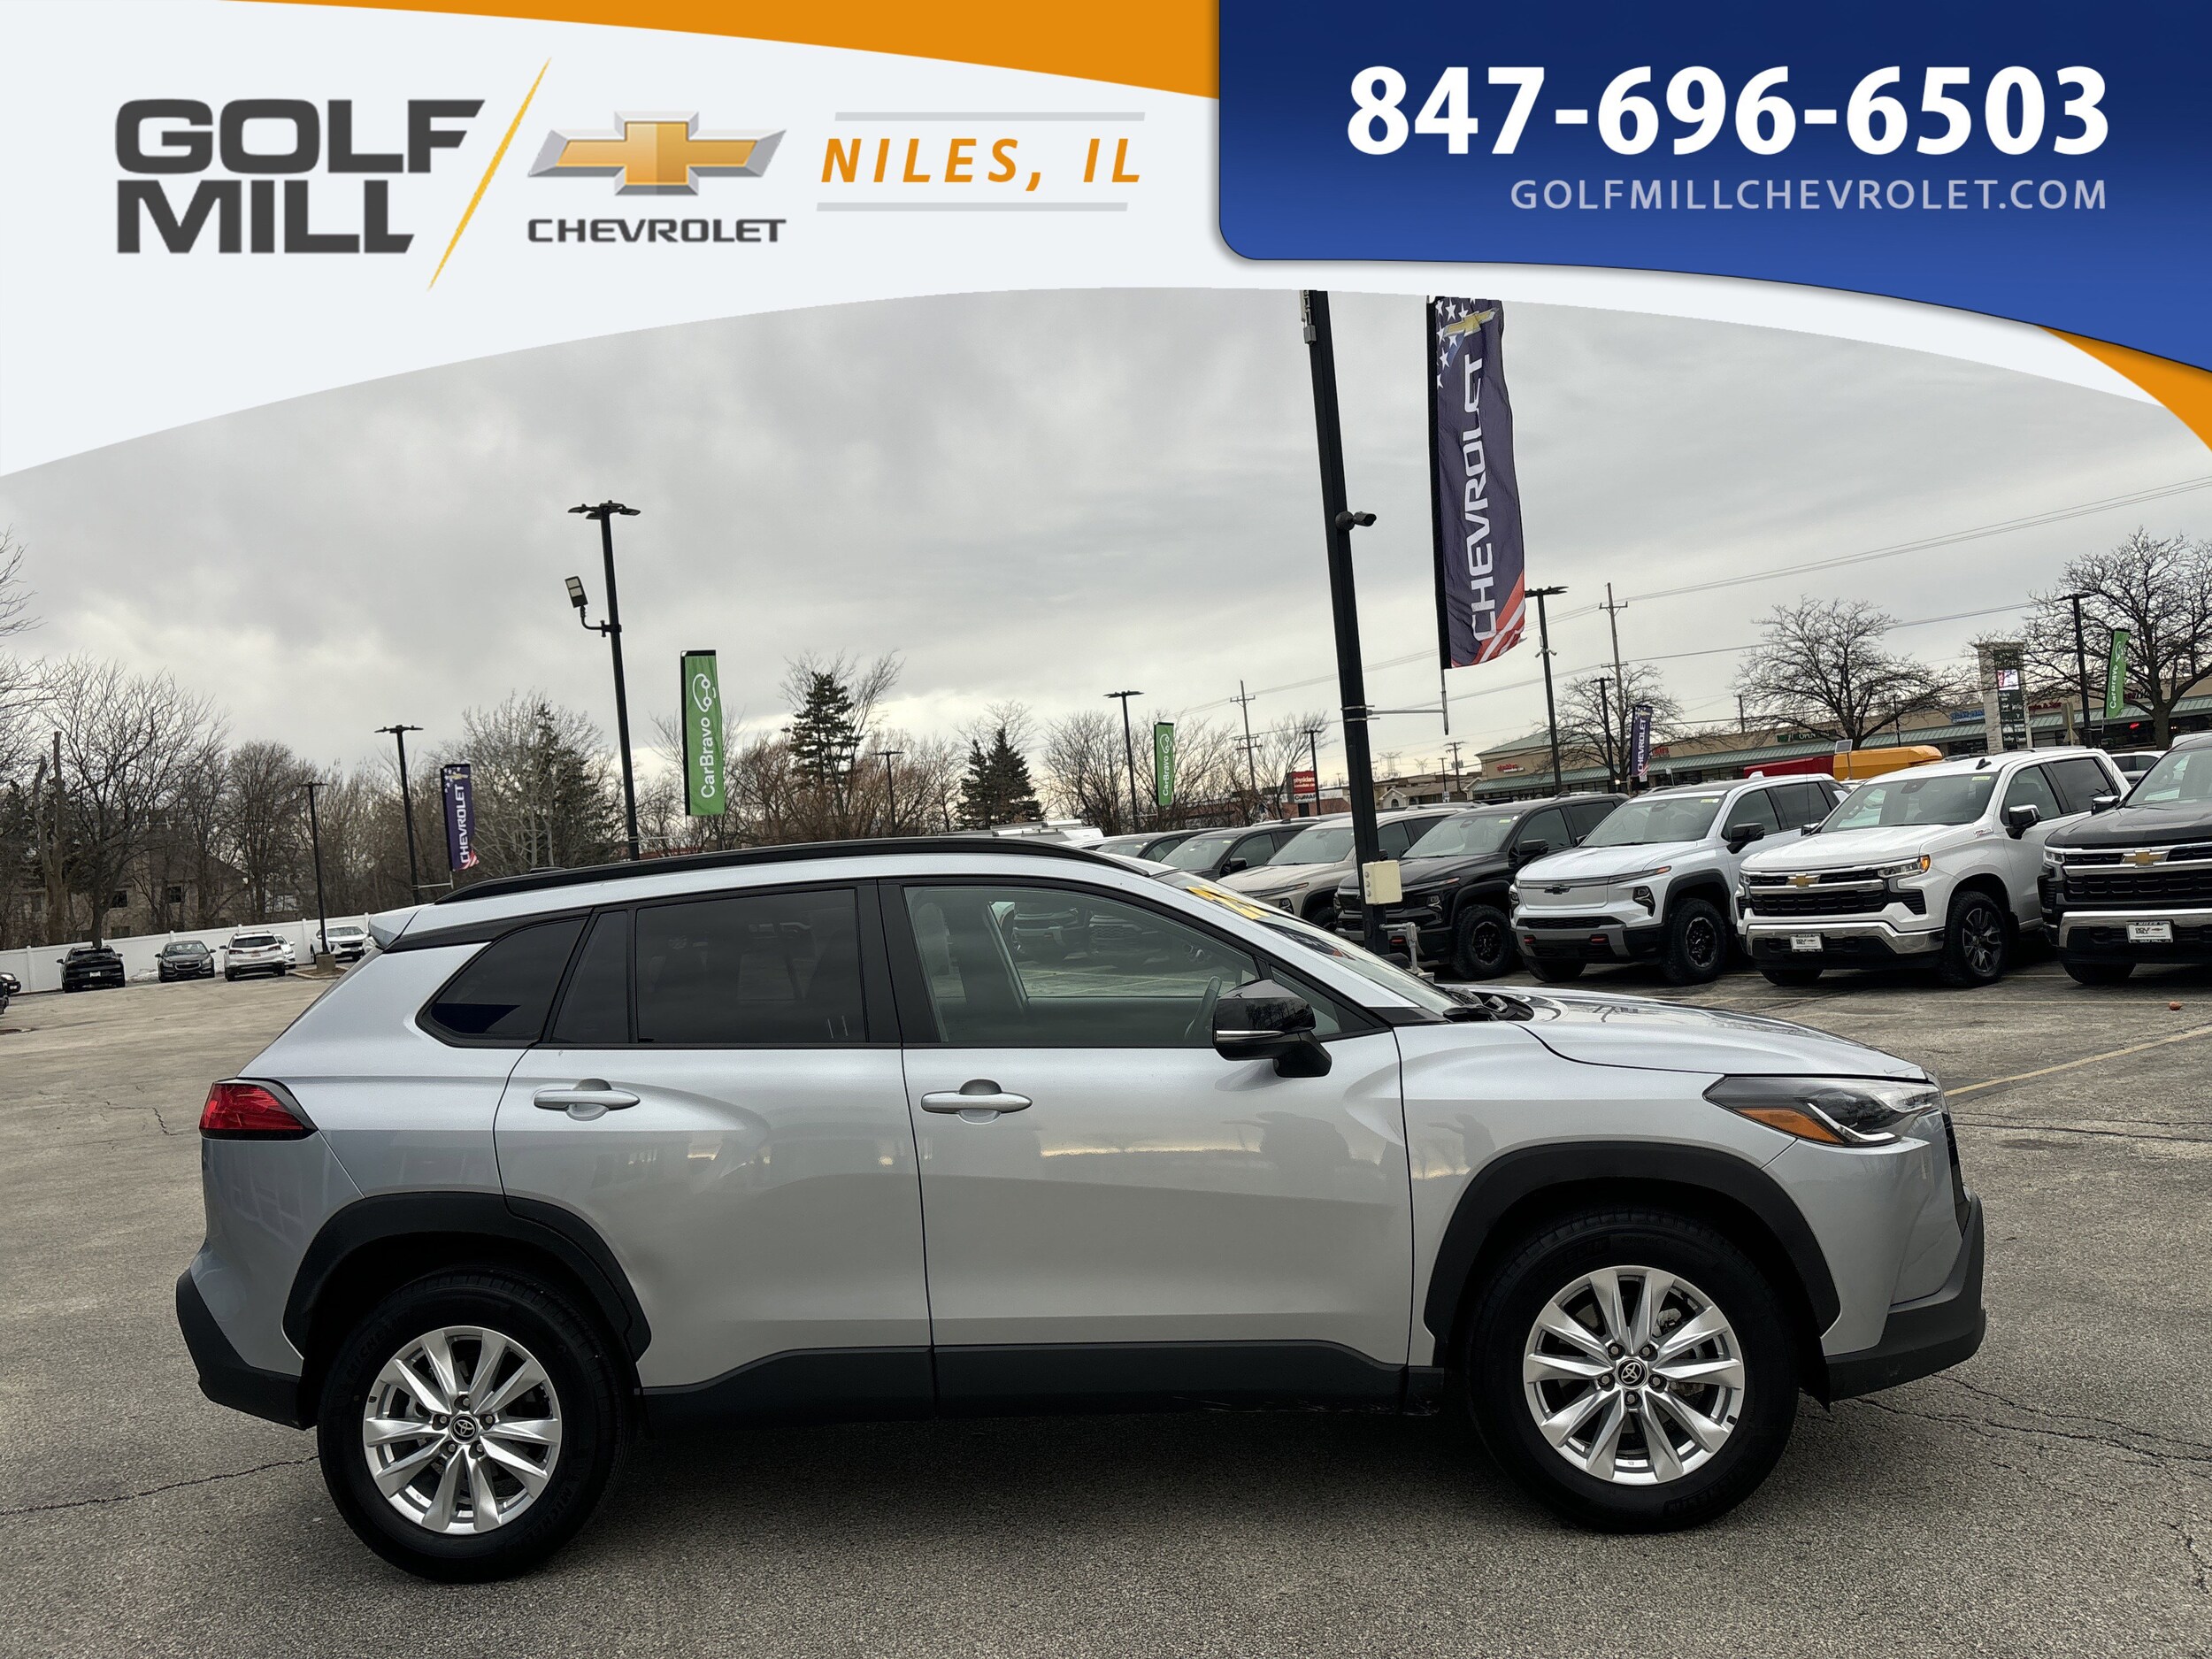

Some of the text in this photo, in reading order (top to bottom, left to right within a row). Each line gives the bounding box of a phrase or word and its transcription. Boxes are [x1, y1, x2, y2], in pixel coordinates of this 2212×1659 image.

[1462, 354, 1497, 641] CHEVROLET
[700, 717, 715, 798] CarBravo
[1638, 718, 1647, 772] CHEVROLET
[455, 784, 470, 864] CHEVROLET
